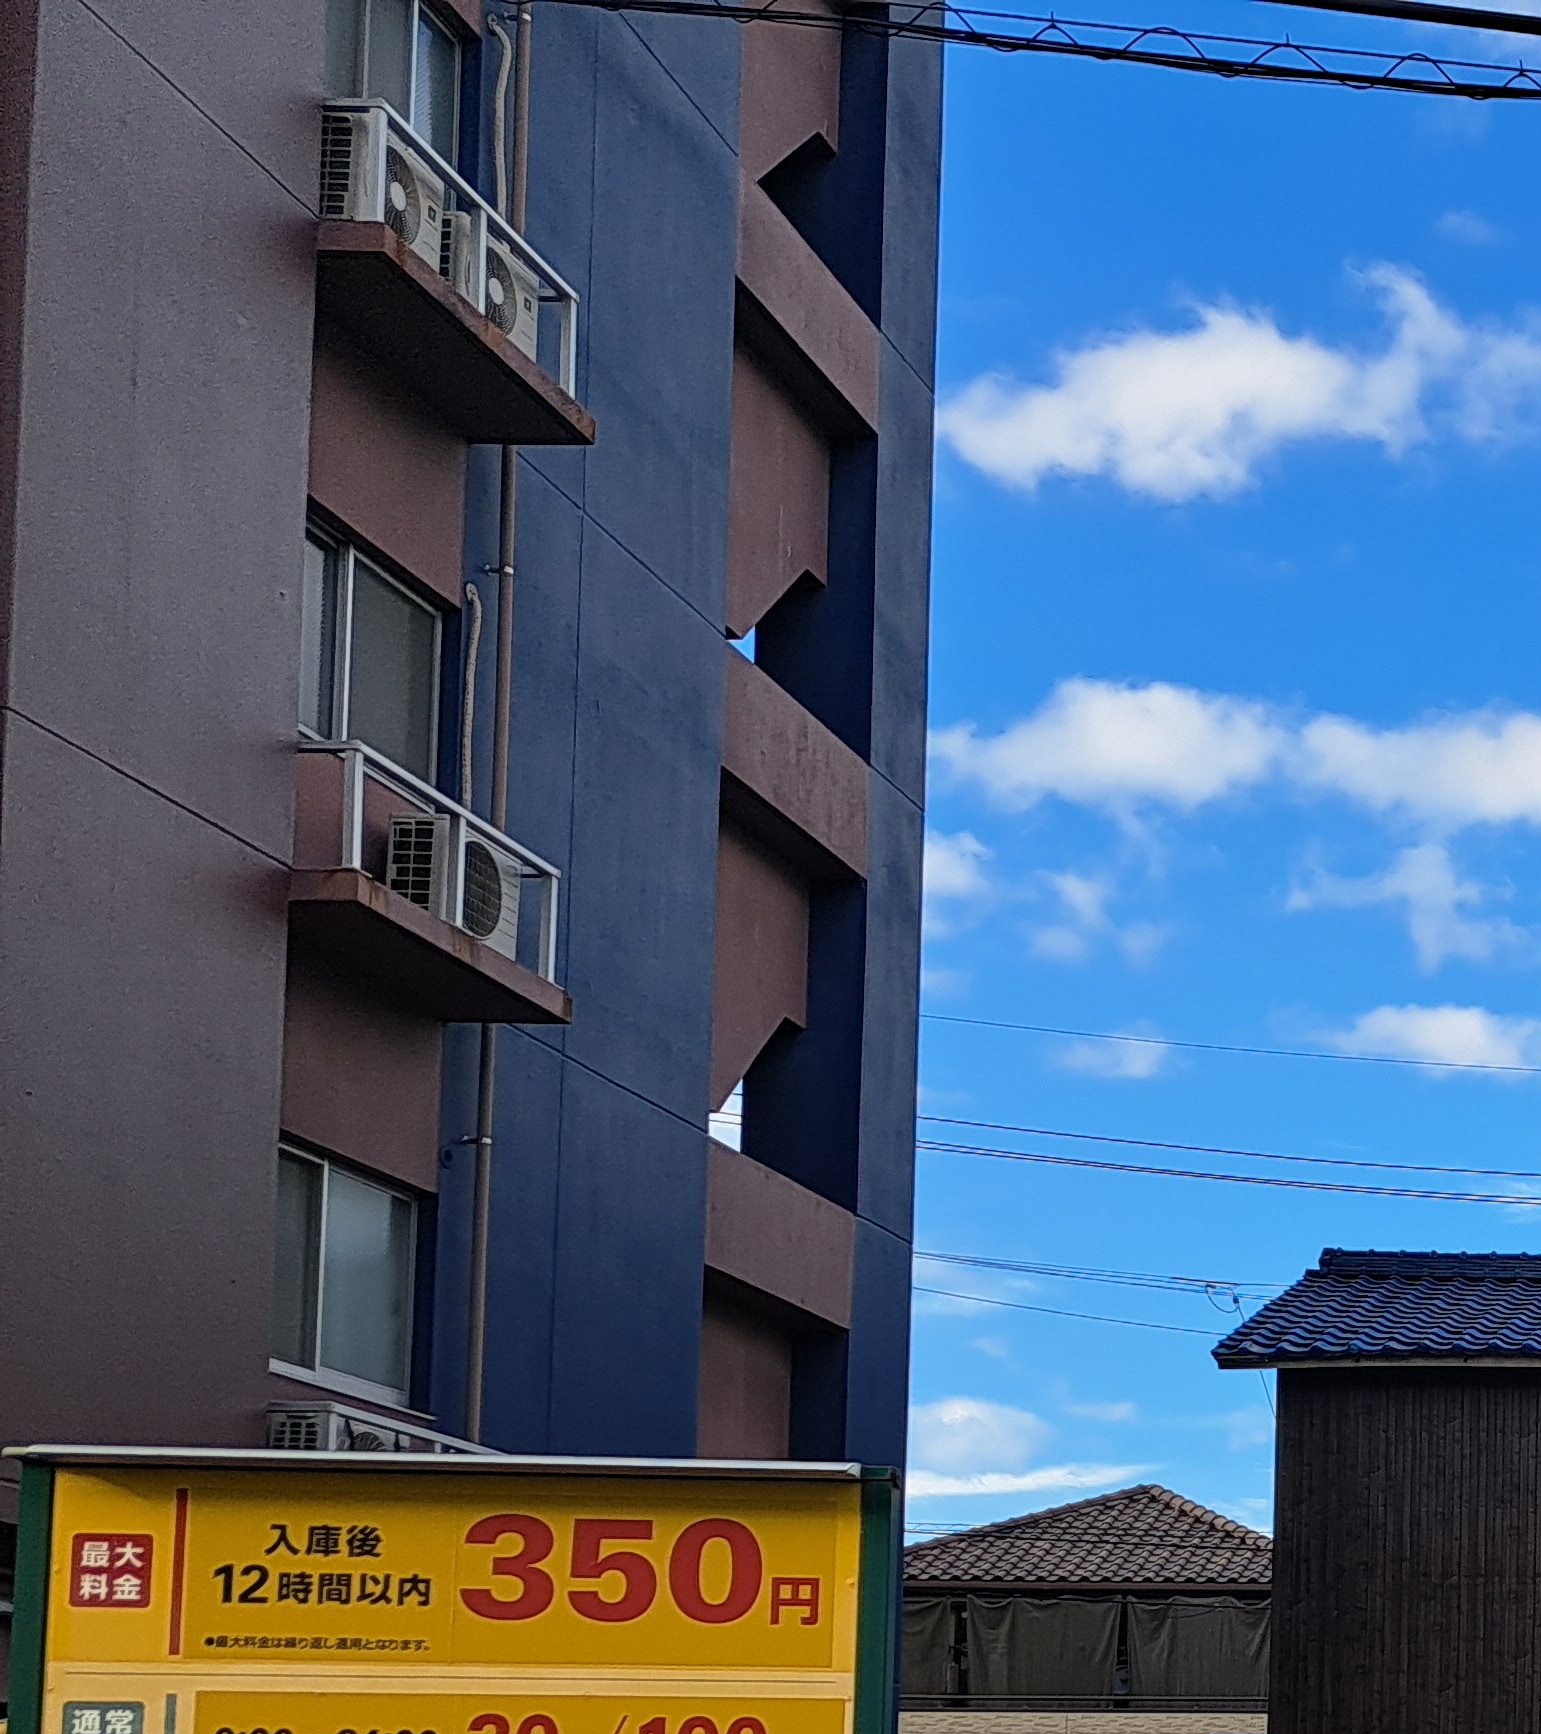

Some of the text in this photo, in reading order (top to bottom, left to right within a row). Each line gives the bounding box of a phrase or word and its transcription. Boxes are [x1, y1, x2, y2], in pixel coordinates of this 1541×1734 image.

[80, 1541, 145, 1569] 最大
[264, 1522, 384, 1558] 入庫後
[79, 1574, 143, 1602] 料金
[212, 1564, 432, 1607] 12時間以内
